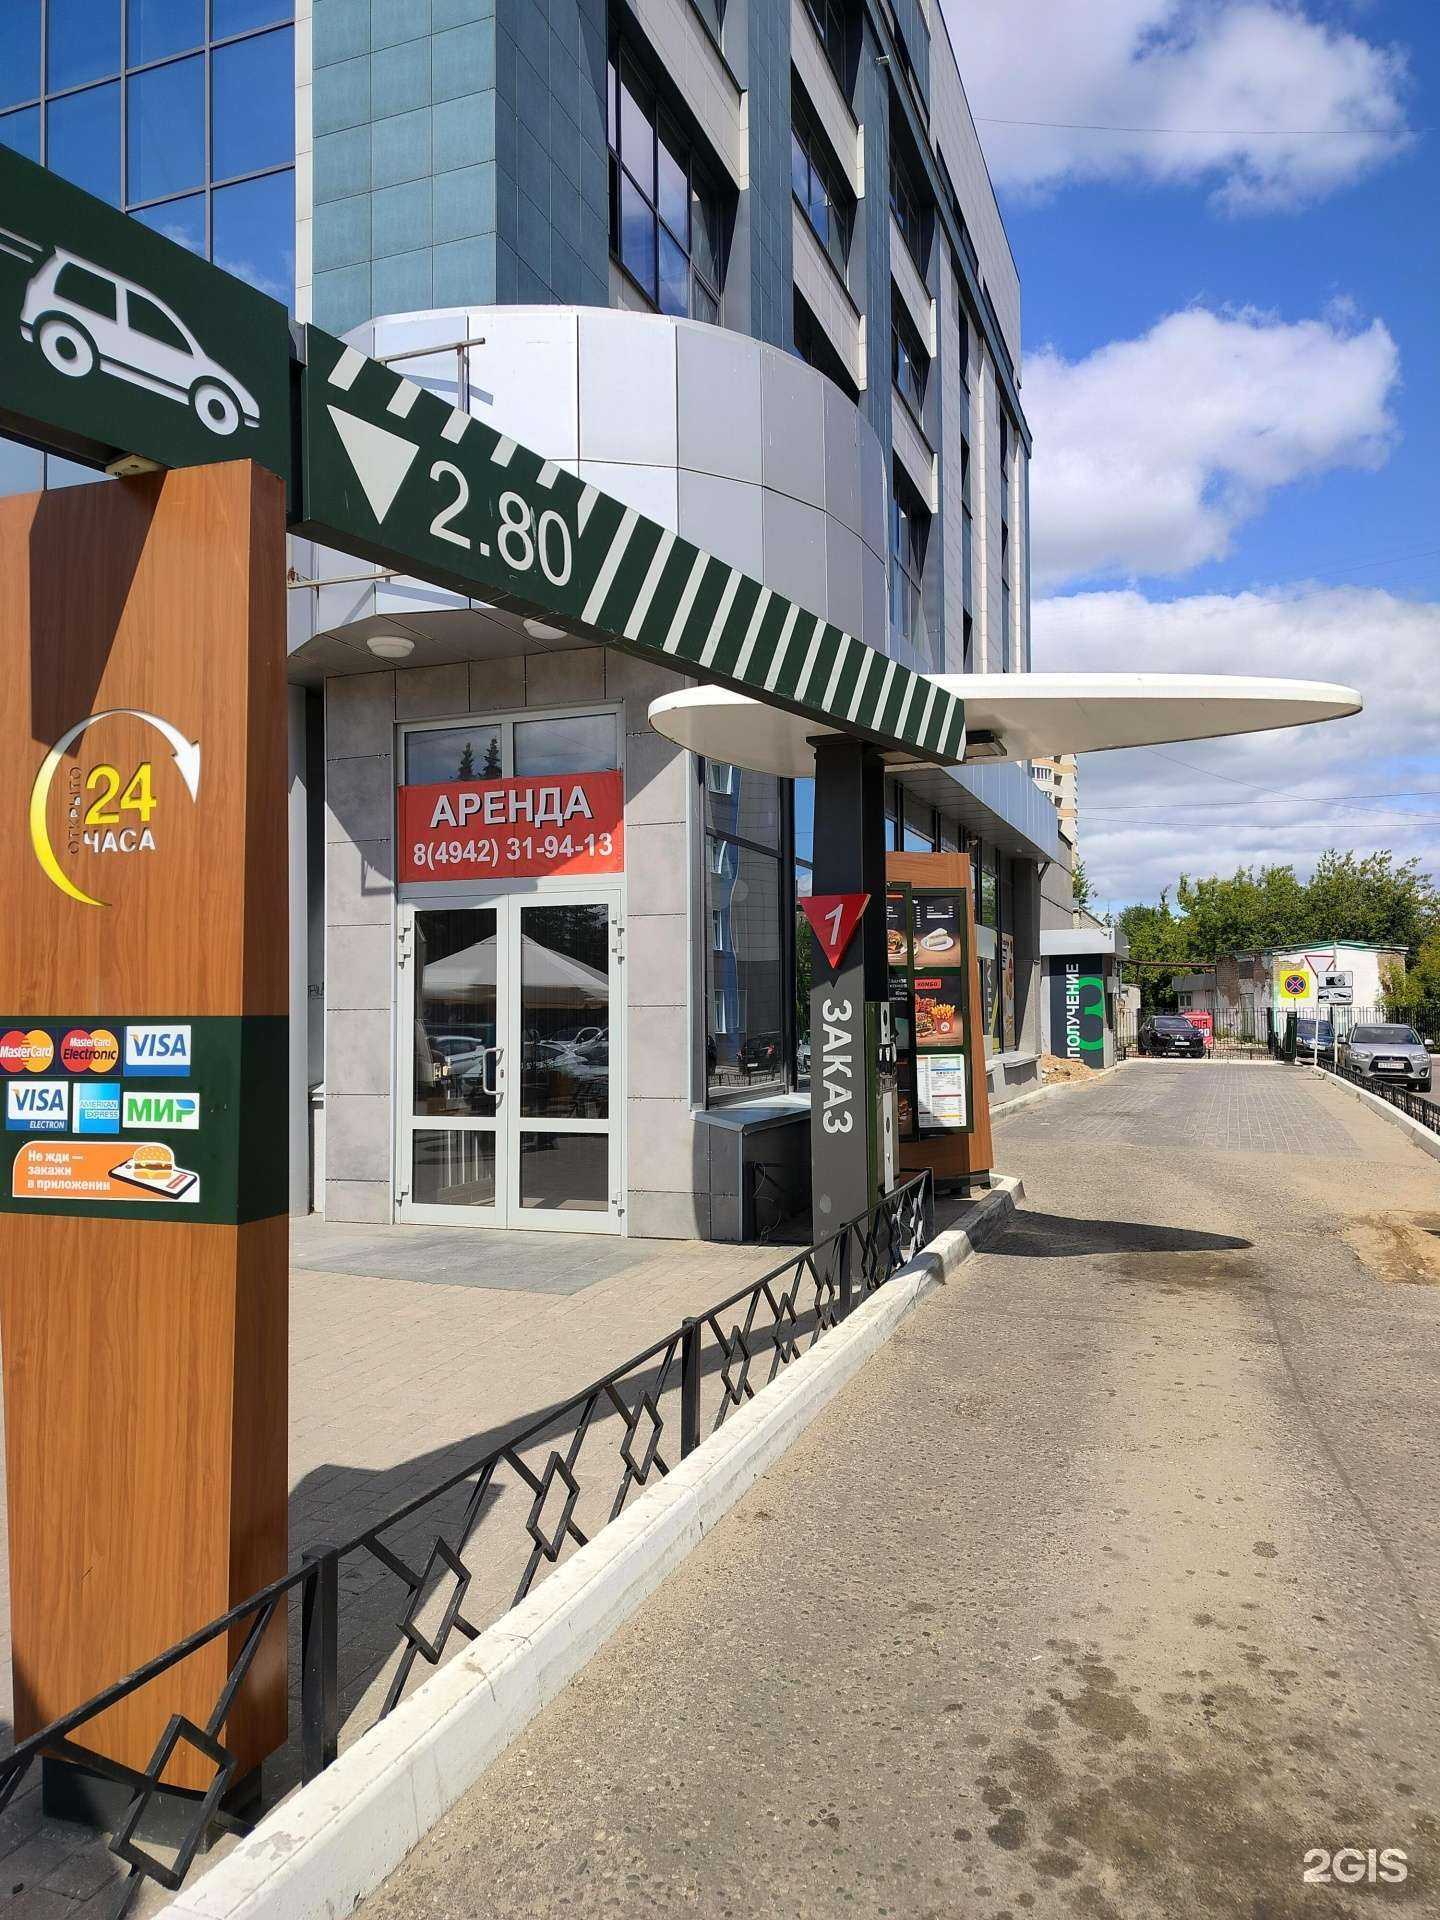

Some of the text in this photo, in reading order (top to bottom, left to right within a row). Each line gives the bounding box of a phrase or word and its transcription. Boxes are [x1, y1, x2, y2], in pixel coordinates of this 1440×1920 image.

[429, 460, 572, 587] 2.80
[83, 761, 157, 825] 24
[430, 785, 593, 828] АРЕНДА
[82, 827, 156, 853] ЧАСА
[413, 838, 499, 871] 8(4942)
[506, 832, 613, 860] 31-94-13
[824, 903, 844, 945] 1
[1065, 962, 1080, 1058] ПОЛУЧЕНИЕ
[1078, 976, 1104, 1051] 3
[0, 1045, 52, 1058] MasterCard
[69, 1037, 112, 1047] MasterCard
[130, 1033, 187, 1057] VISA
[63, 1048, 117, 1061] Electronic
[821, 998, 854, 1134] ЗАКАЗ
[12, 1088, 65, 1111] VISA
[80, 1100, 117, 1109] AMERICAN
[127, 1097, 197, 1122] МИР
[29, 1120, 65, 1129] ELECTRON
[86, 1110, 119, 1118] EXPRESS
[28, 1150, 43, 1162] Не
[45, 1152, 70, 1164] жди
[27, 1166, 72, 1176] закажи
[27, 1180, 111, 1192] в приложении
